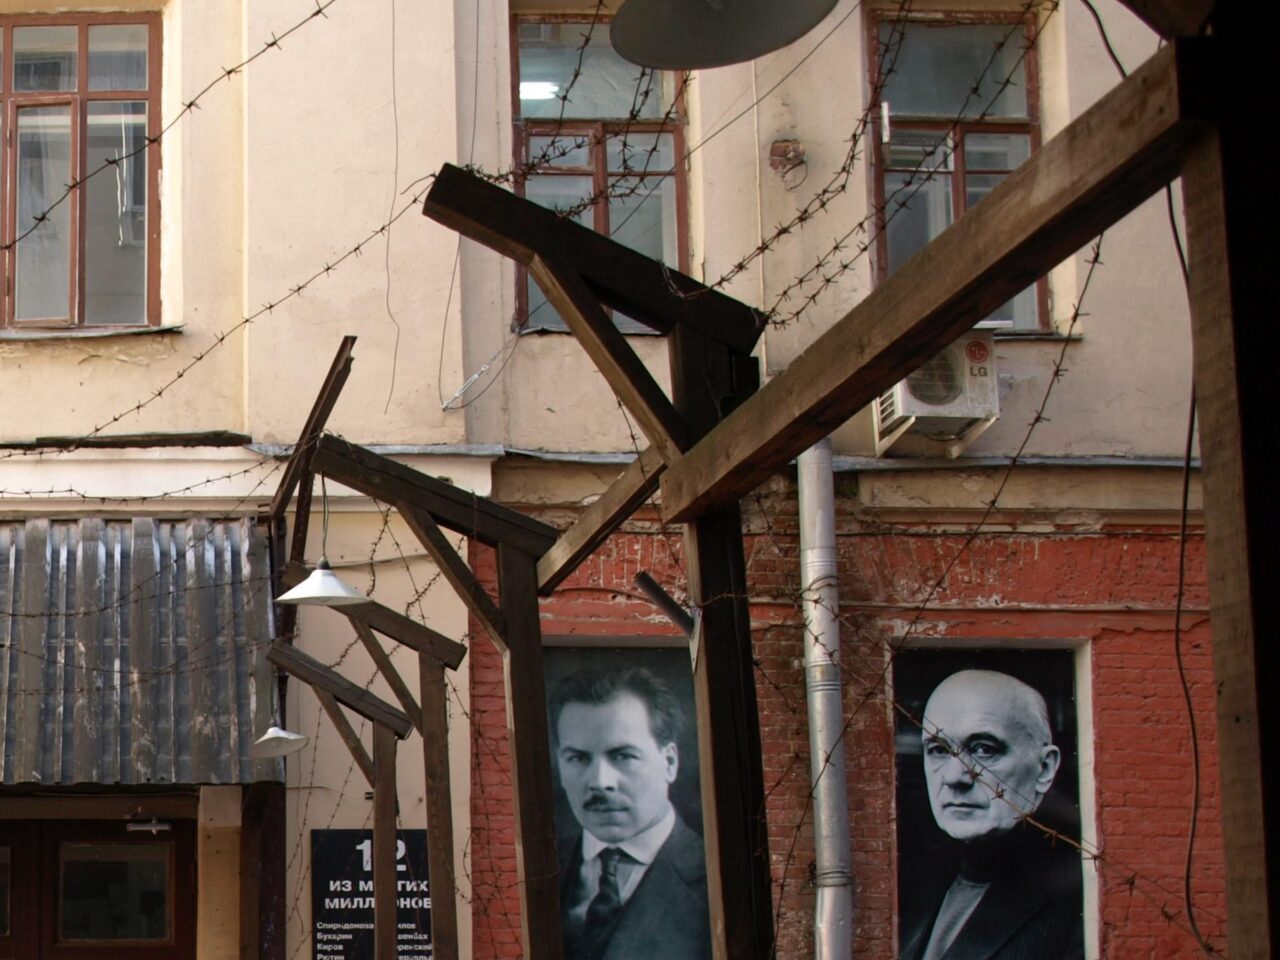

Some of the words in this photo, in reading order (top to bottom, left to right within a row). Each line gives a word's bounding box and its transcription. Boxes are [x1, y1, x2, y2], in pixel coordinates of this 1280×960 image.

[970, 366, 988, 377] LG
[329, 880, 352, 892] ИЗ
[359, 880, 429, 892] МГИХ
[325, 897, 432, 909] МИЛЛНОВ
[317, 932, 353, 941] Бухарин
[317, 943, 344, 951] Киров
[317, 953, 345, 960] Рютин
